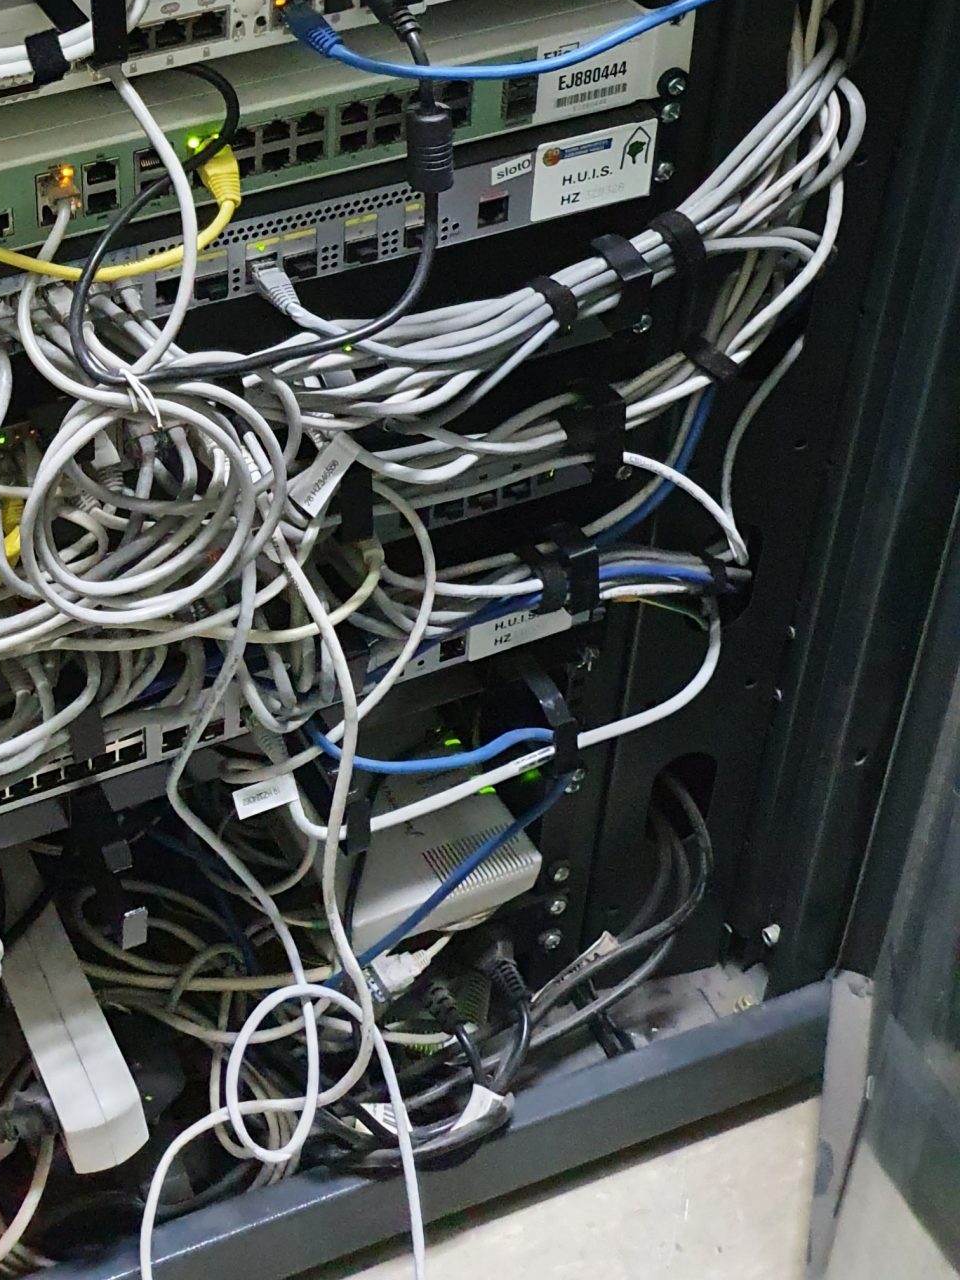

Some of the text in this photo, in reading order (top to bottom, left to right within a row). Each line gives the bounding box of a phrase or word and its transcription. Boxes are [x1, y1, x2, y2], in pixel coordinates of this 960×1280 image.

[558, 60, 628, 91] EJ880444
[562, 164, 614, 186] H.U.I.S.
[560, 192, 581, 206] HZ
[494, 611, 539, 632] H.U.I.S
[493, 632, 513, 647] HZ
